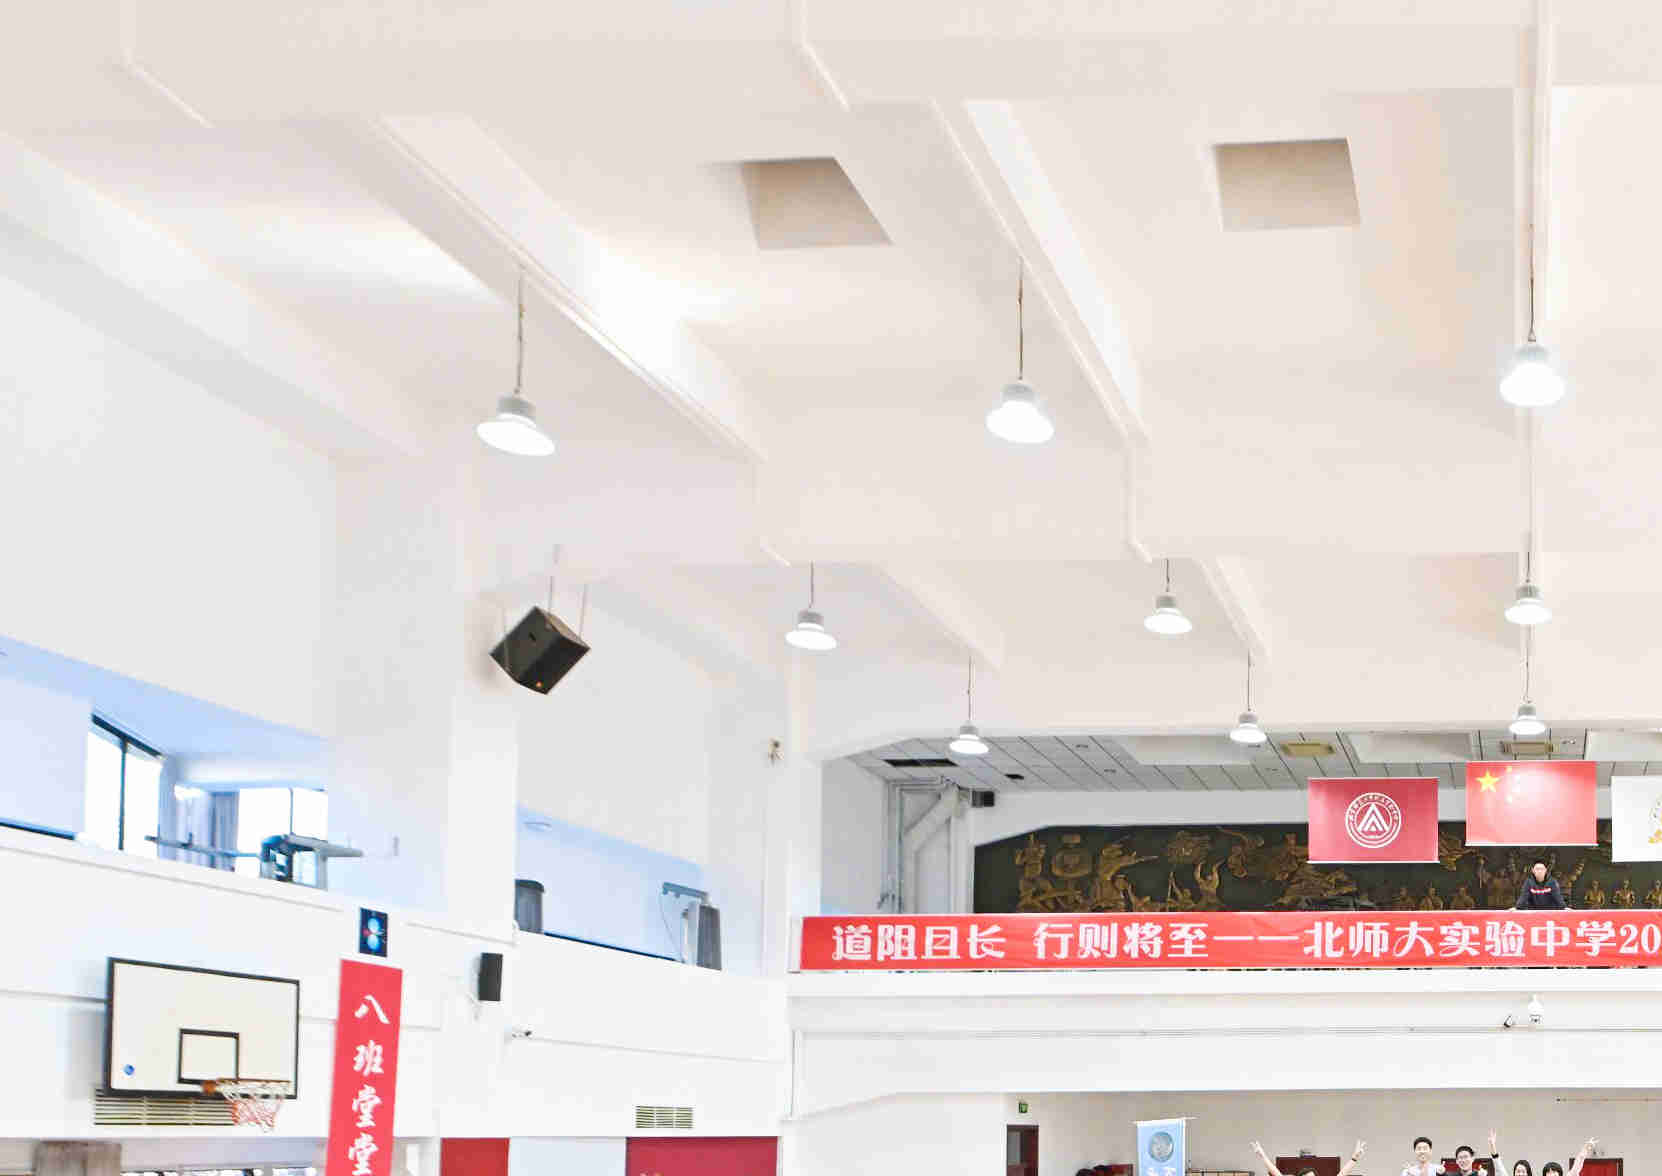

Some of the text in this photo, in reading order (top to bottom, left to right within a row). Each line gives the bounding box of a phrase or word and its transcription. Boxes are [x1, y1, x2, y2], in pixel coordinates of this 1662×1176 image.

[833, 924, 1006, 961] 道阻且长
[347, 993, 392, 1176] 八班堂堂
